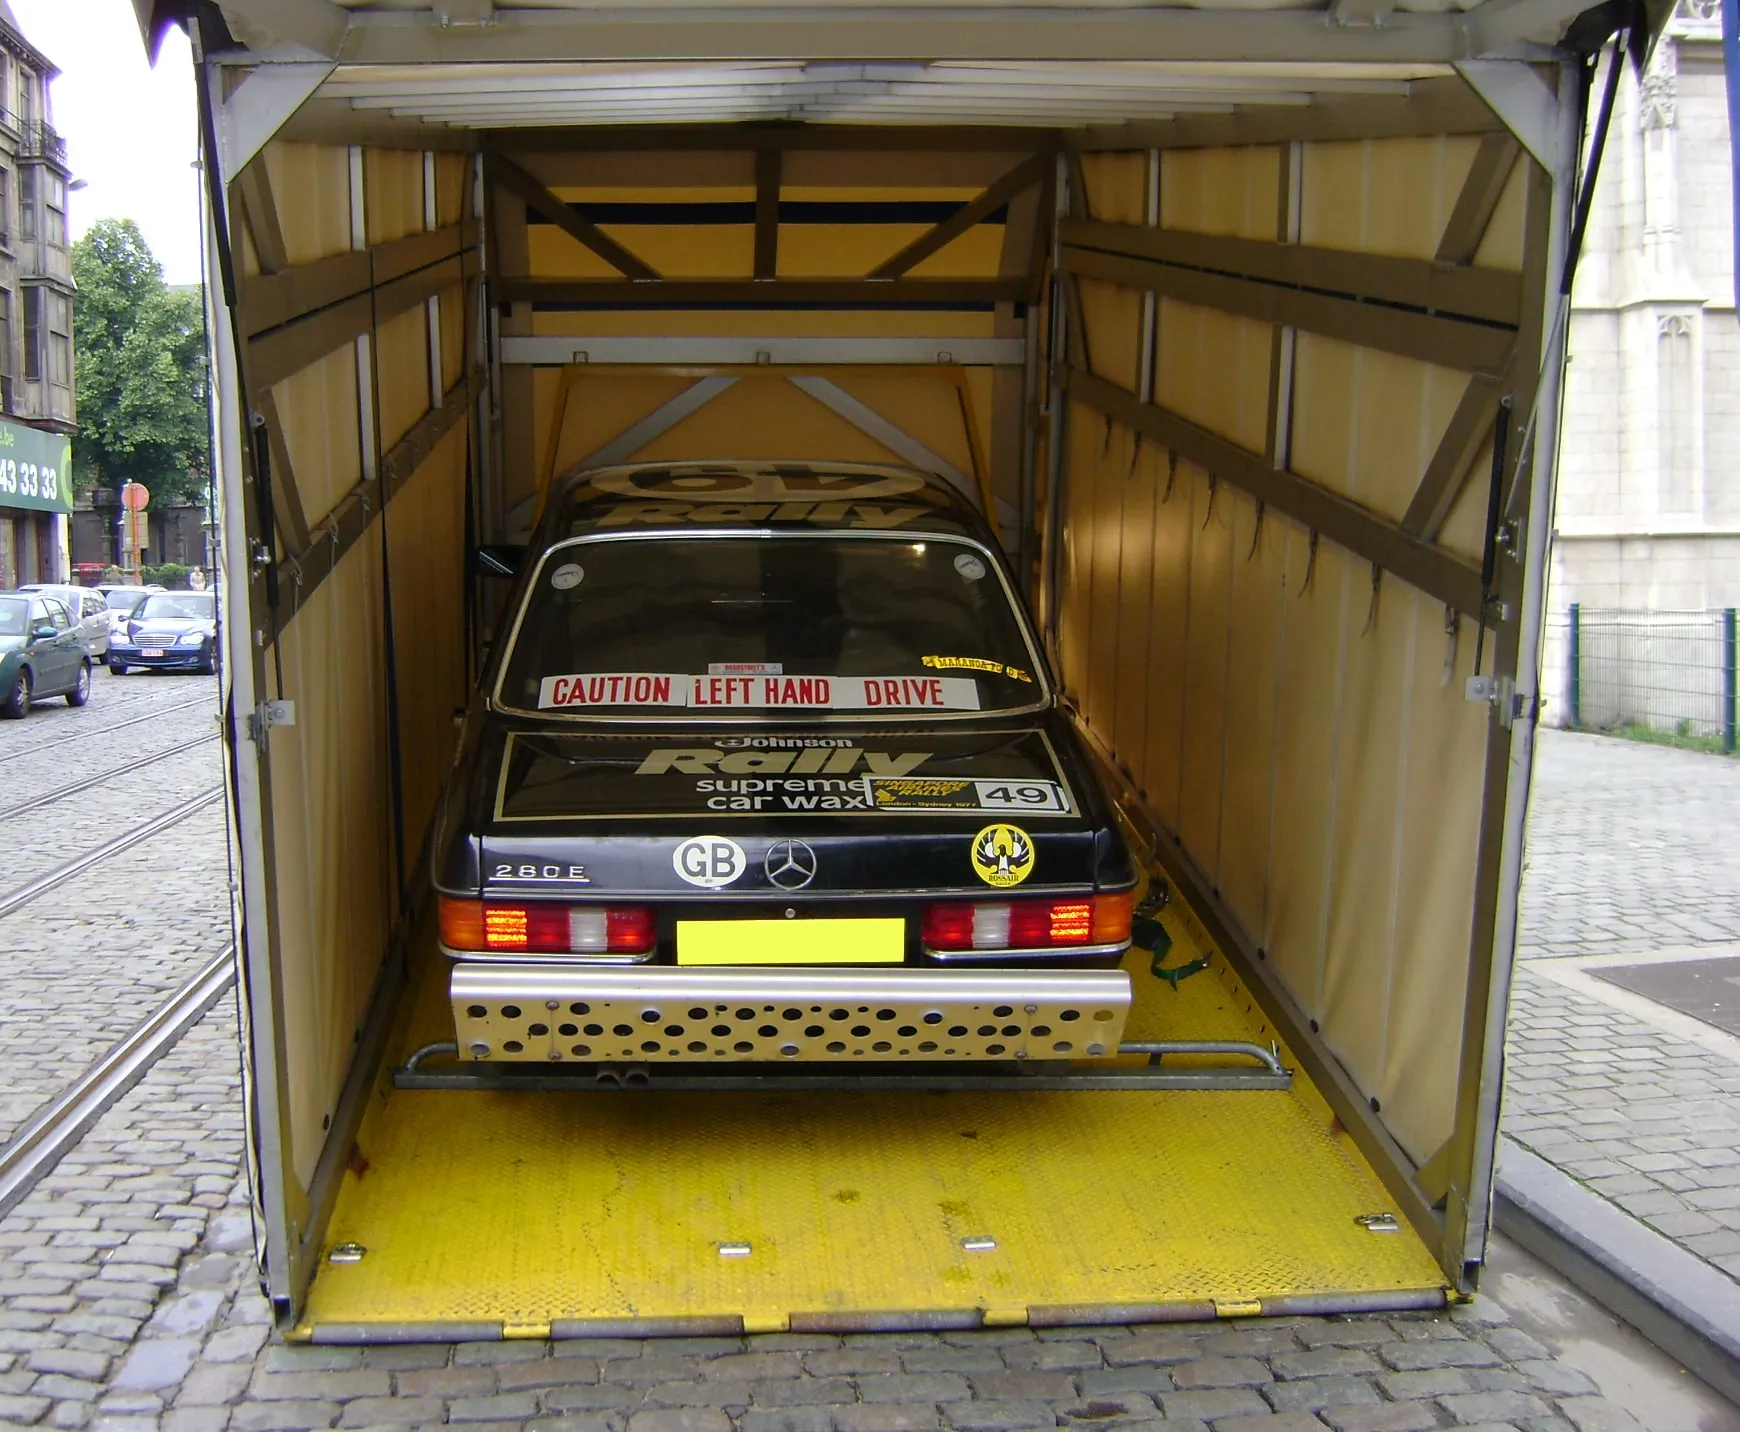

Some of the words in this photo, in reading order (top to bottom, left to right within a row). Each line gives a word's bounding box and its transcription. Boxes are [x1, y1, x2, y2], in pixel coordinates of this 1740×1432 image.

[20, 462, 38, 497] 33
[41, 466, 58, 500] 33
[597, 502, 938, 528] Rally
[552, 676, 671, 705] CAUTION
[694, 678, 755, 705] LEFT
[765, 678, 830, 705] HAND
[864, 679, 944, 706] DRIVE
[714, 737, 853, 748] Johnson
[635, 748, 934, 776] Rally
[696, 779, 865, 795] supreme
[873, 780, 970, 788] SINGAPORE
[898, 789, 952, 797] RALLY
[985, 786, 1048, 804] 49
[706, 795, 773, 810] car
[780, 795, 868, 810] wax
[681, 842, 736, 878] GB
[988, 874, 1019, 882] ROSSAIR
